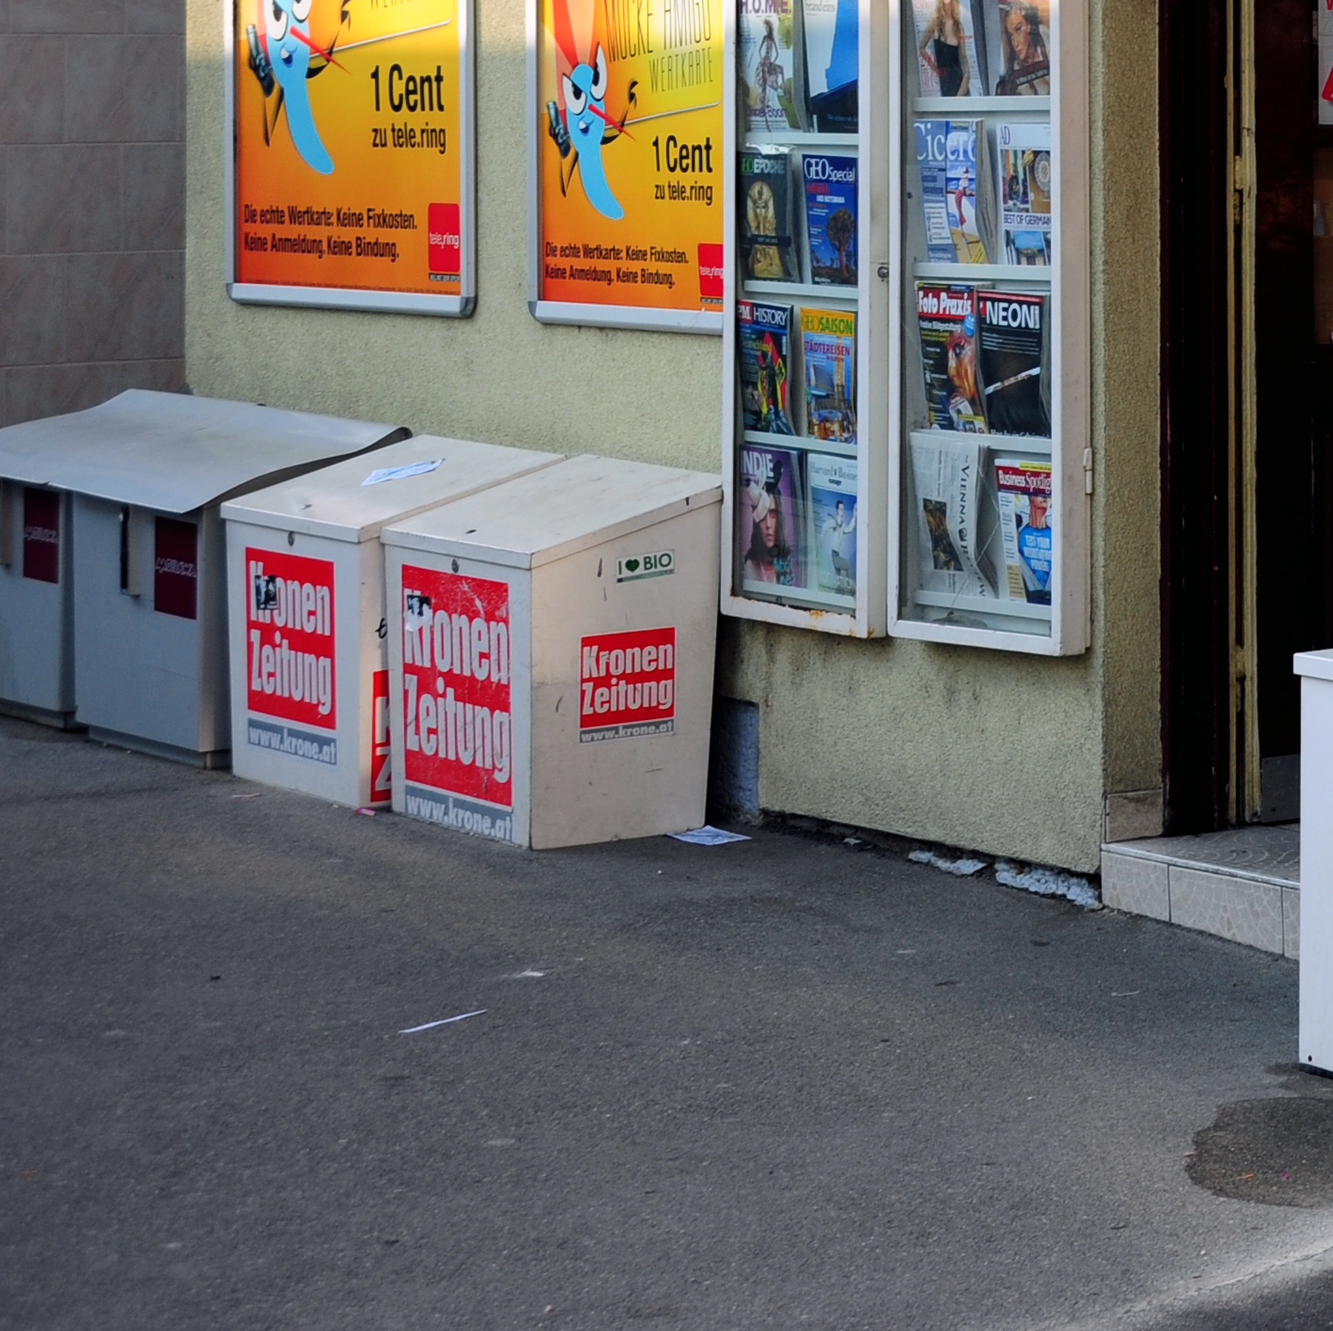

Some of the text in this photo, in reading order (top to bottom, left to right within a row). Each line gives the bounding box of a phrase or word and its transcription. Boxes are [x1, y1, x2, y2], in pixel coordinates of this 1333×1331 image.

[370, 63, 445, 113] 1 Cent
[371, 122, 446, 154] zu tele.ring
[652, 135, 714, 174] 1 Cent
[804, 157, 855, 183] GEO Special
[654, 178, 713, 206] zu tele.ring
[244, 204, 257, 225] Die
[259, 204, 285, 225] echte
[336, 207, 364, 229] Keine
[366, 207, 418, 231] Fixkosten.
[244, 232, 400, 263] Keine Anmeldung. Keine Bindung.
[545, 242, 557, 257] Die
[559, 243, 581, 259] echte
[625, 245, 648, 262] Keine
[650, 246, 689, 264] Fixkosten.
[545, 264, 567, 279] Keine
[616, 266, 639, 284] Keine
[640, 267, 676, 289] Bindung.
[753, 306, 788, 326] HISTORY
[918, 290, 973, 316] Foto Praxis
[985, 300, 1033, 329] NEON
[959, 464, 971, 525] VIENNA
[643, 552, 673, 571] BIO
[249, 628, 333, 717] Zeitung
[582, 641, 674, 680] Kronen
[581, 679, 674, 717] Zeitung
[404, 673, 512, 785] Zeitung
[580, 720, 674, 744] www.krone.at
[248, 728, 337, 765] www.krone.at
